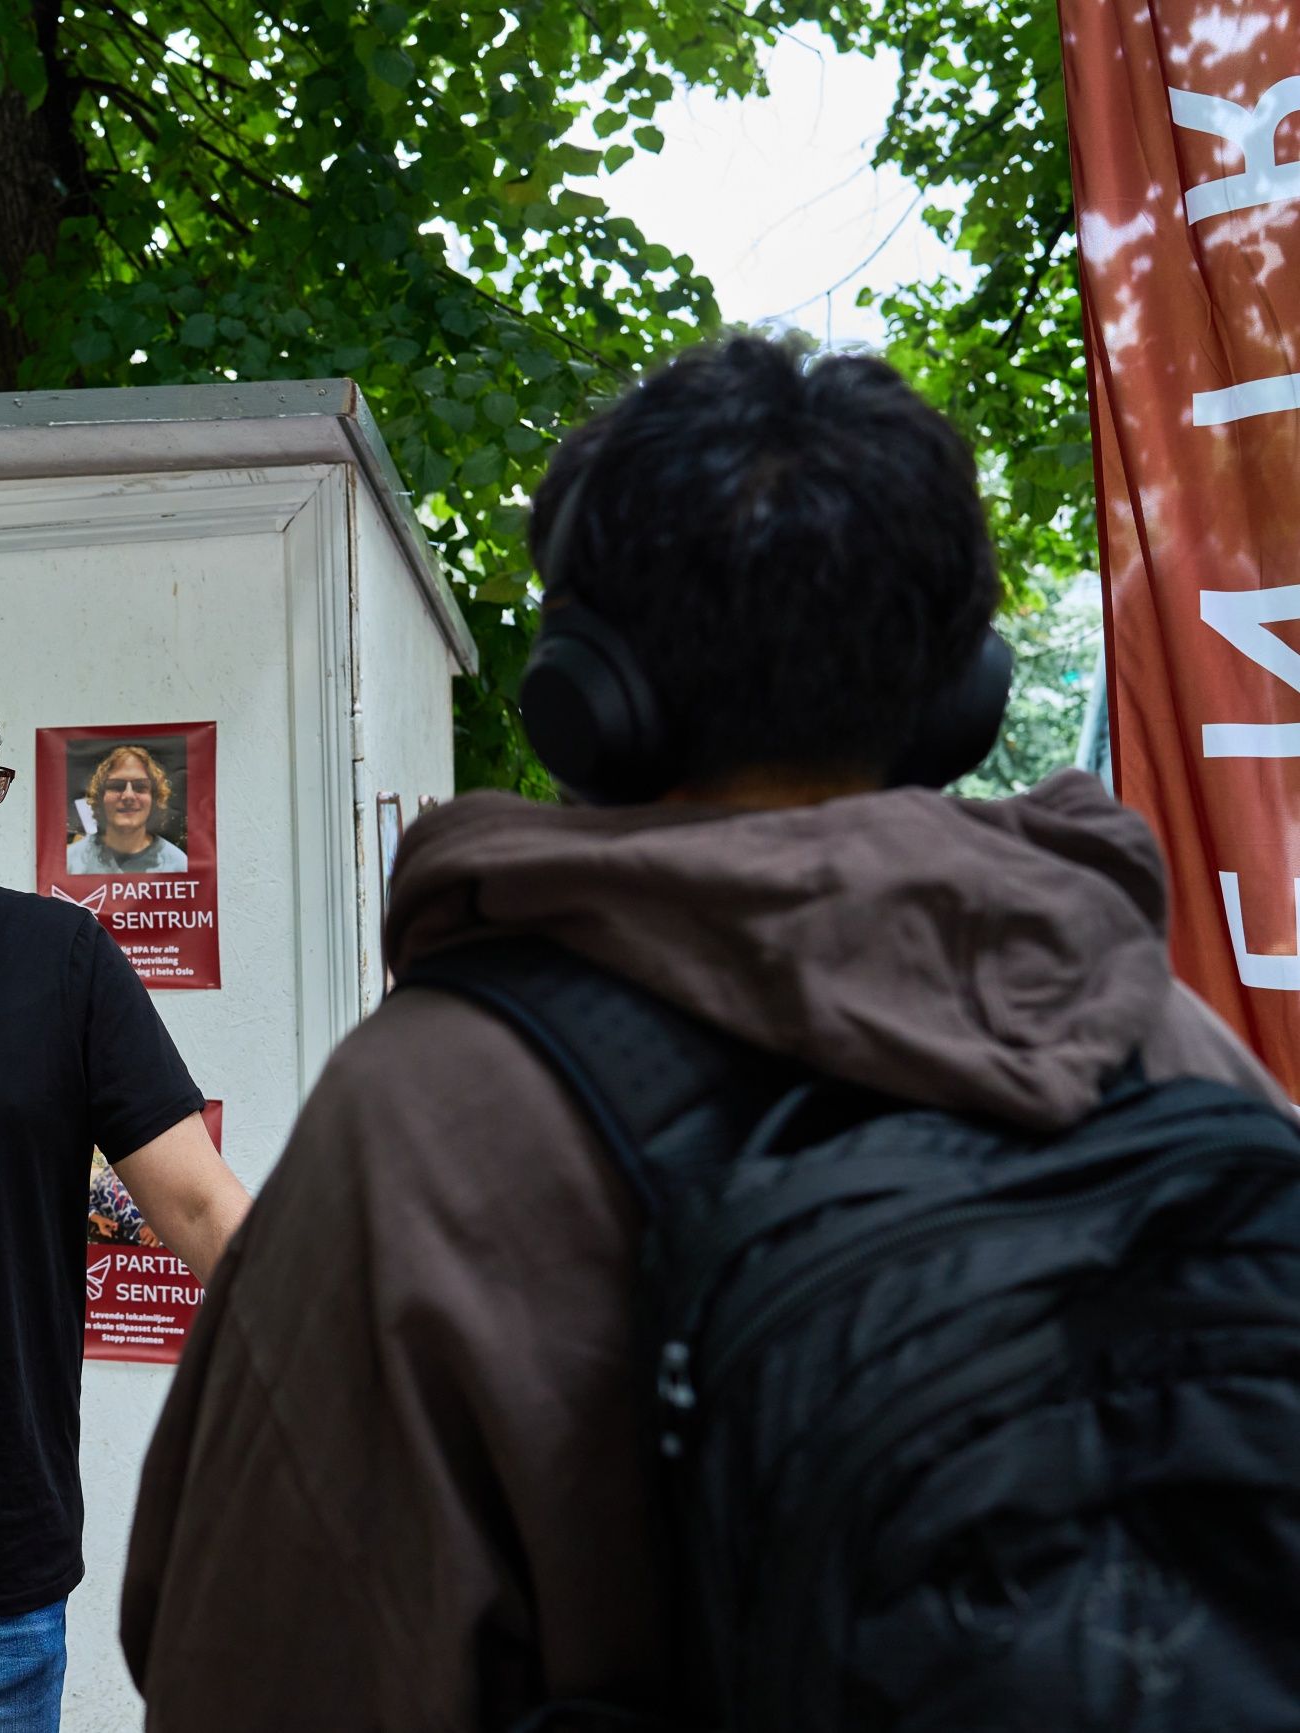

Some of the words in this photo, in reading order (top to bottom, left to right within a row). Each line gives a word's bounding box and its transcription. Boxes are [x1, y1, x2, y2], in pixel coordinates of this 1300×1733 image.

[112, 881, 199, 900] PARTIET
[112, 911, 213, 929] SENTRUM
[132, 945, 150, 954] BPA
[150, 945, 163, 954] for
[164, 945, 180, 954] alle
[132, 957, 179, 966] byutvikling
[156, 967, 174, 976] hele
[175, 967, 194, 976] Oslo
[116, 1254, 190, 1275] PARTIE
[90, 1311, 125, 1320] Levende
[92, 1322, 115, 1331] skole
[115, 1323, 151, 1333] tilpasset
[152, 1325, 185, 1335] elevene
[101, 1333, 125, 1344] Stopp
[126, 1335, 164, 1345] rasismen
